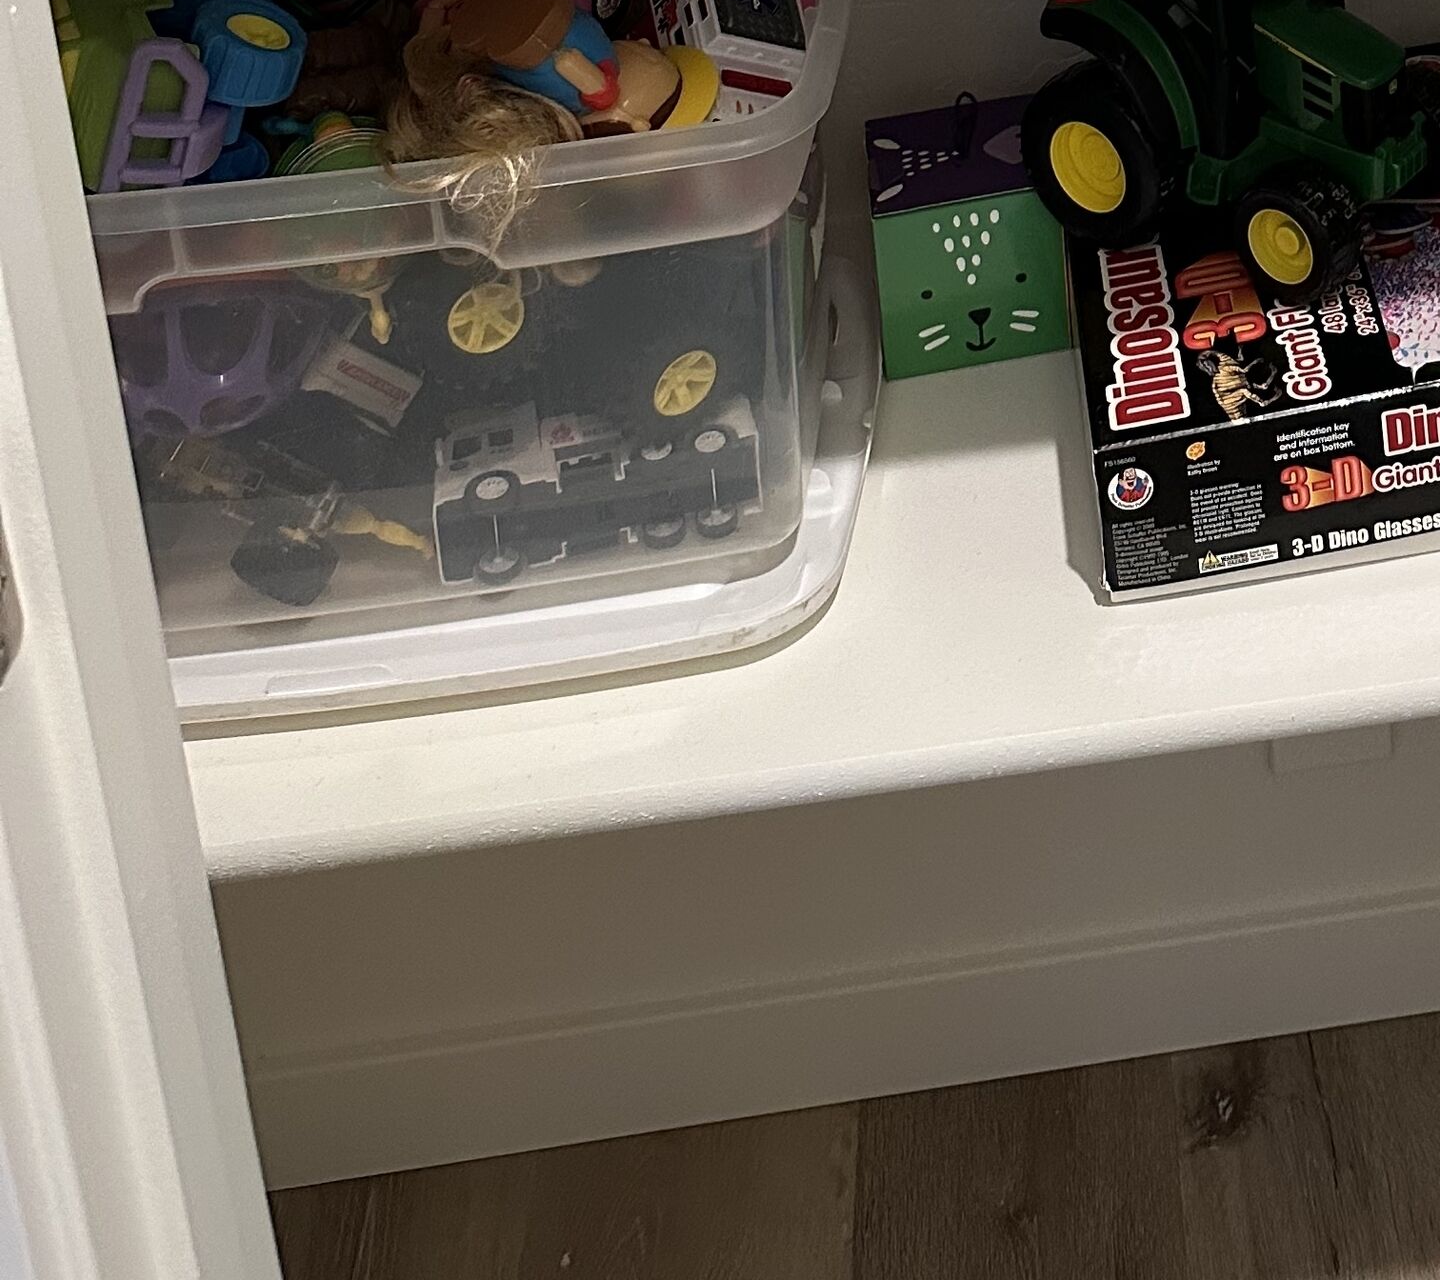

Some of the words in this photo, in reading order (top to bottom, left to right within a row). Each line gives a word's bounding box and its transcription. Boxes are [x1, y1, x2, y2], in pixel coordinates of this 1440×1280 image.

[1175, 254, 1267, 350] 3-D
[1102, 244, 1190, 430] Dinosaur
[1321, 312, 1348, 333] 48
[1276, 329, 1331, 400] Giant
[1276, 426, 1332, 442] Identification
[1333, 422, 1350, 432] key
[1279, 440, 1297, 451] and
[1298, 432, 1349, 447] information
[1273, 452, 1289, 461] are
[1290, 450, 1302, 458] on
[1303, 446, 1320, 455] box
[1322, 440, 1355, 452] bottom.
[1280, 455, 1366, 513] 3-D
[1291, 534, 1324, 557] 3-D
[1328, 528, 1369, 551] Dino
